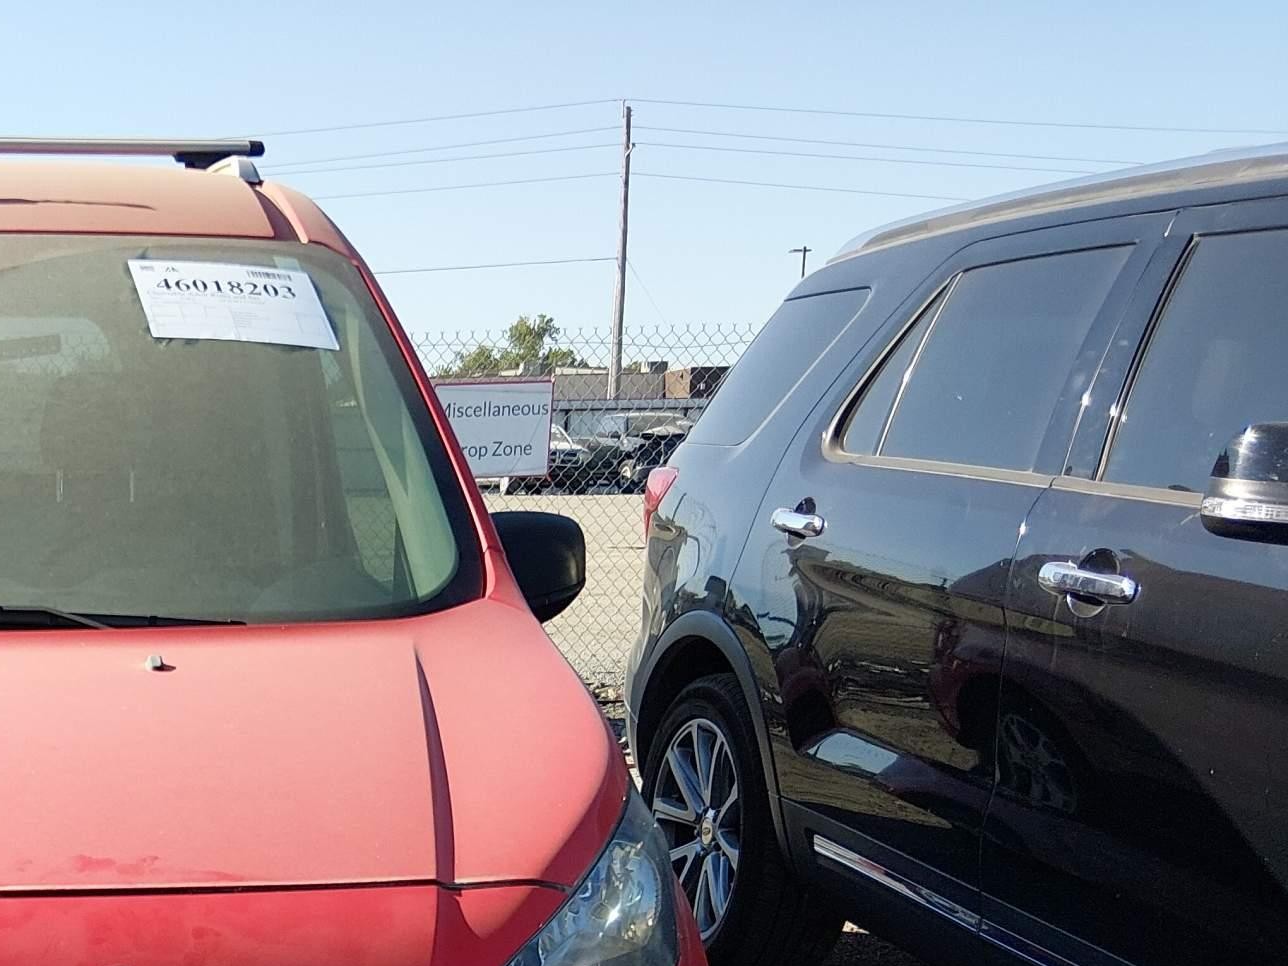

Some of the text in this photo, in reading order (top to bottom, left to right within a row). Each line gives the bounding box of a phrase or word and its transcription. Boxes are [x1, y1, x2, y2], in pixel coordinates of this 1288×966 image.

[156, 278, 297, 300] 46018203
[461, 441, 533, 461] rop Zone
